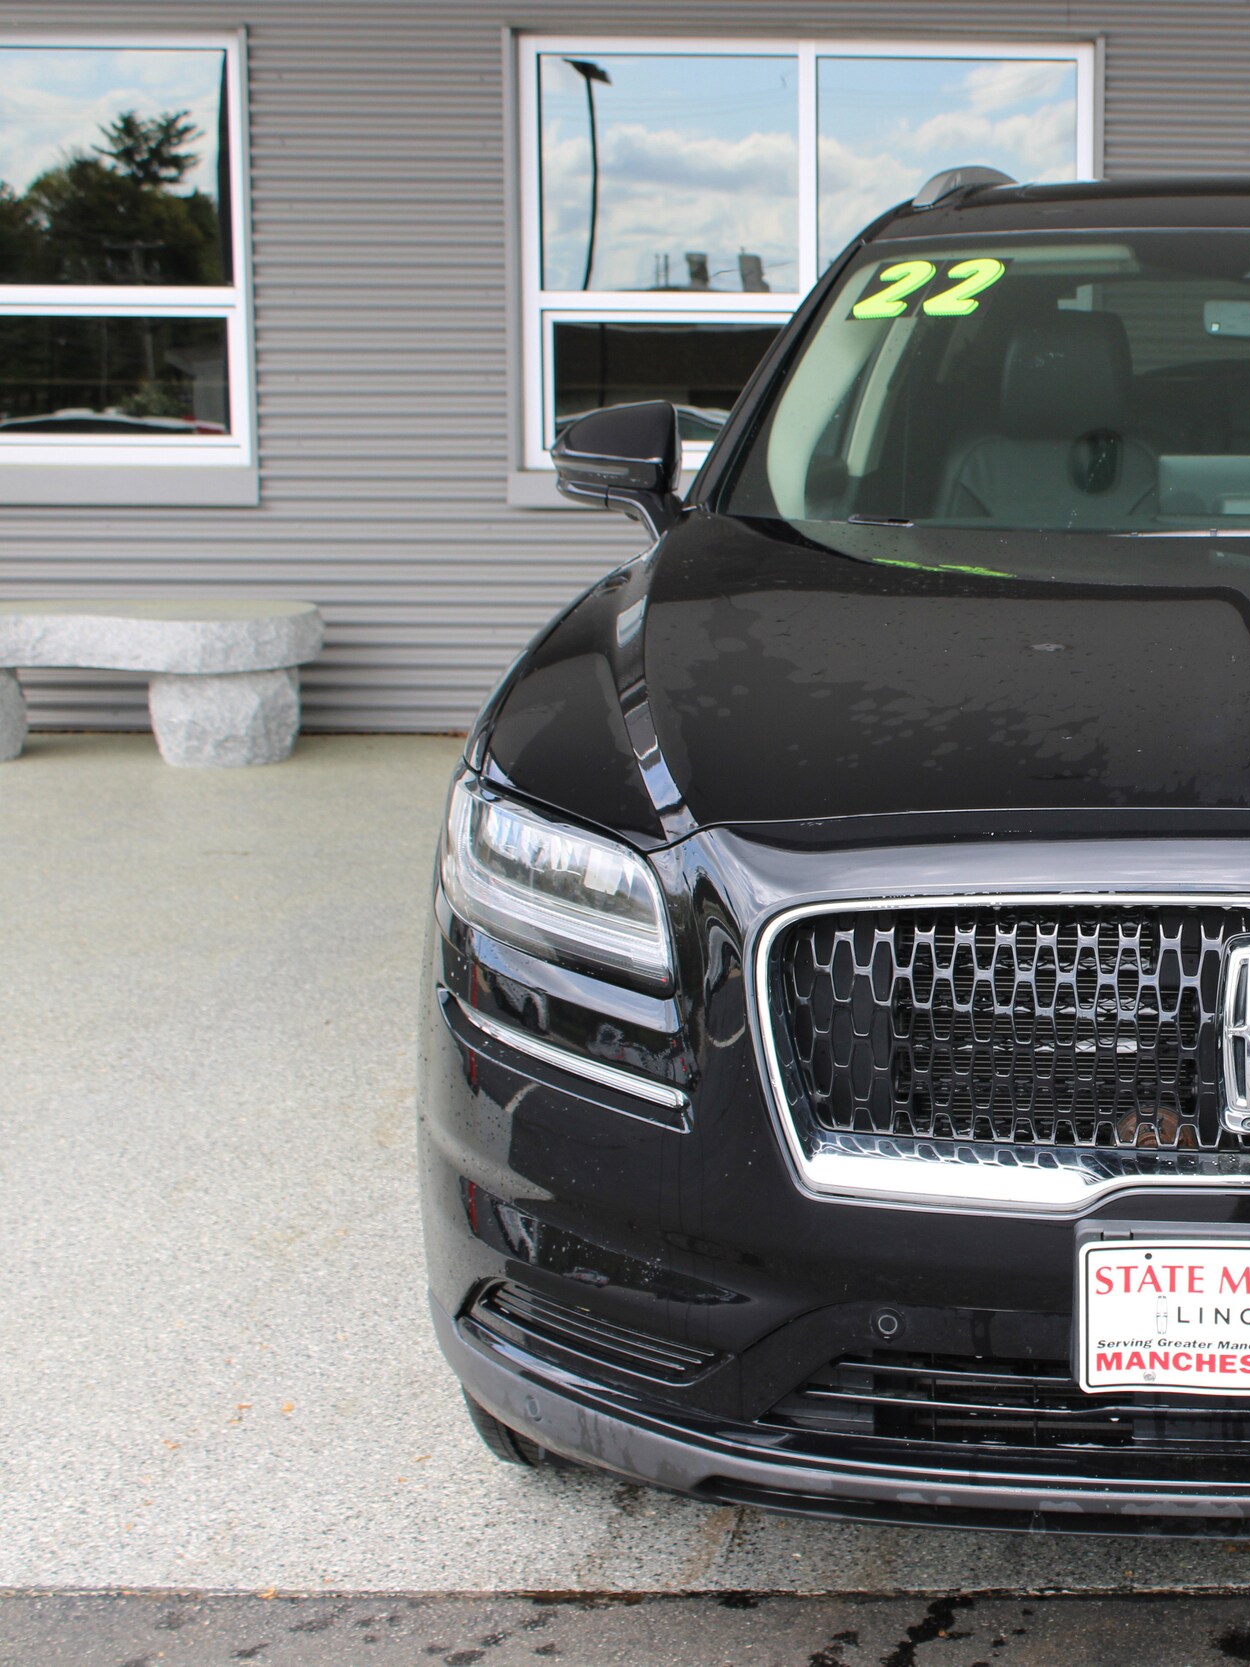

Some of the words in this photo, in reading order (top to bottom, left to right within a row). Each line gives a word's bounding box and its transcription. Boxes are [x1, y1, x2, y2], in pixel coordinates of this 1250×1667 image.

[853, 258, 1006, 319] 22
[1095, 1265, 1204, 1295] STATE
[1097, 1338, 1152, 1349] Serving
[1157, 1338, 1211, 1349] Greater
